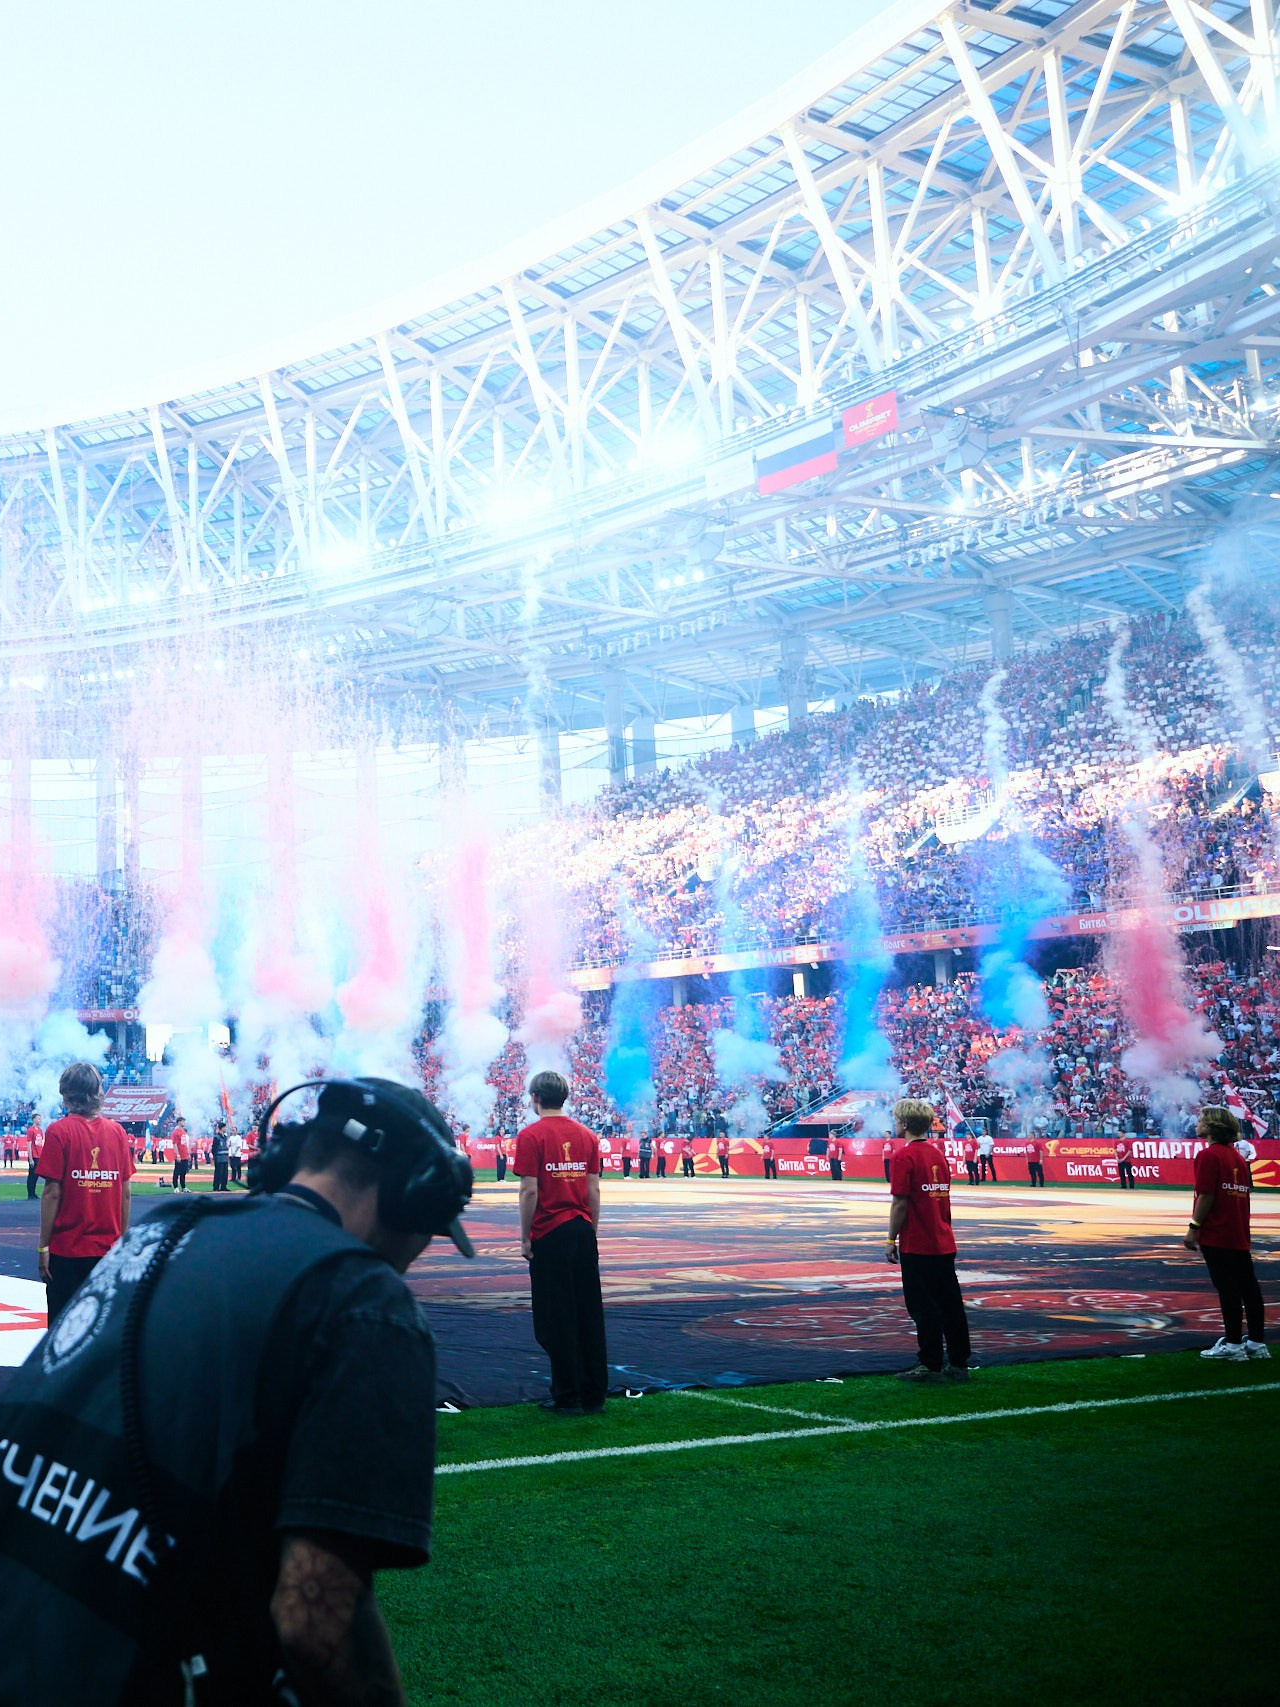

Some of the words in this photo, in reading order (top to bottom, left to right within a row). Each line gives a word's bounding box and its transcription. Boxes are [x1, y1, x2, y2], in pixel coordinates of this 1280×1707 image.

[750, 945, 830, 966] LIMPBET
[993, 1146, 1027, 1154] OLIMP
[1132, 1141, 1209, 1159] СПАРТА
[71, 1169, 119, 1180] OLMPBET
[1124, 1165, 1160, 1178] олге
